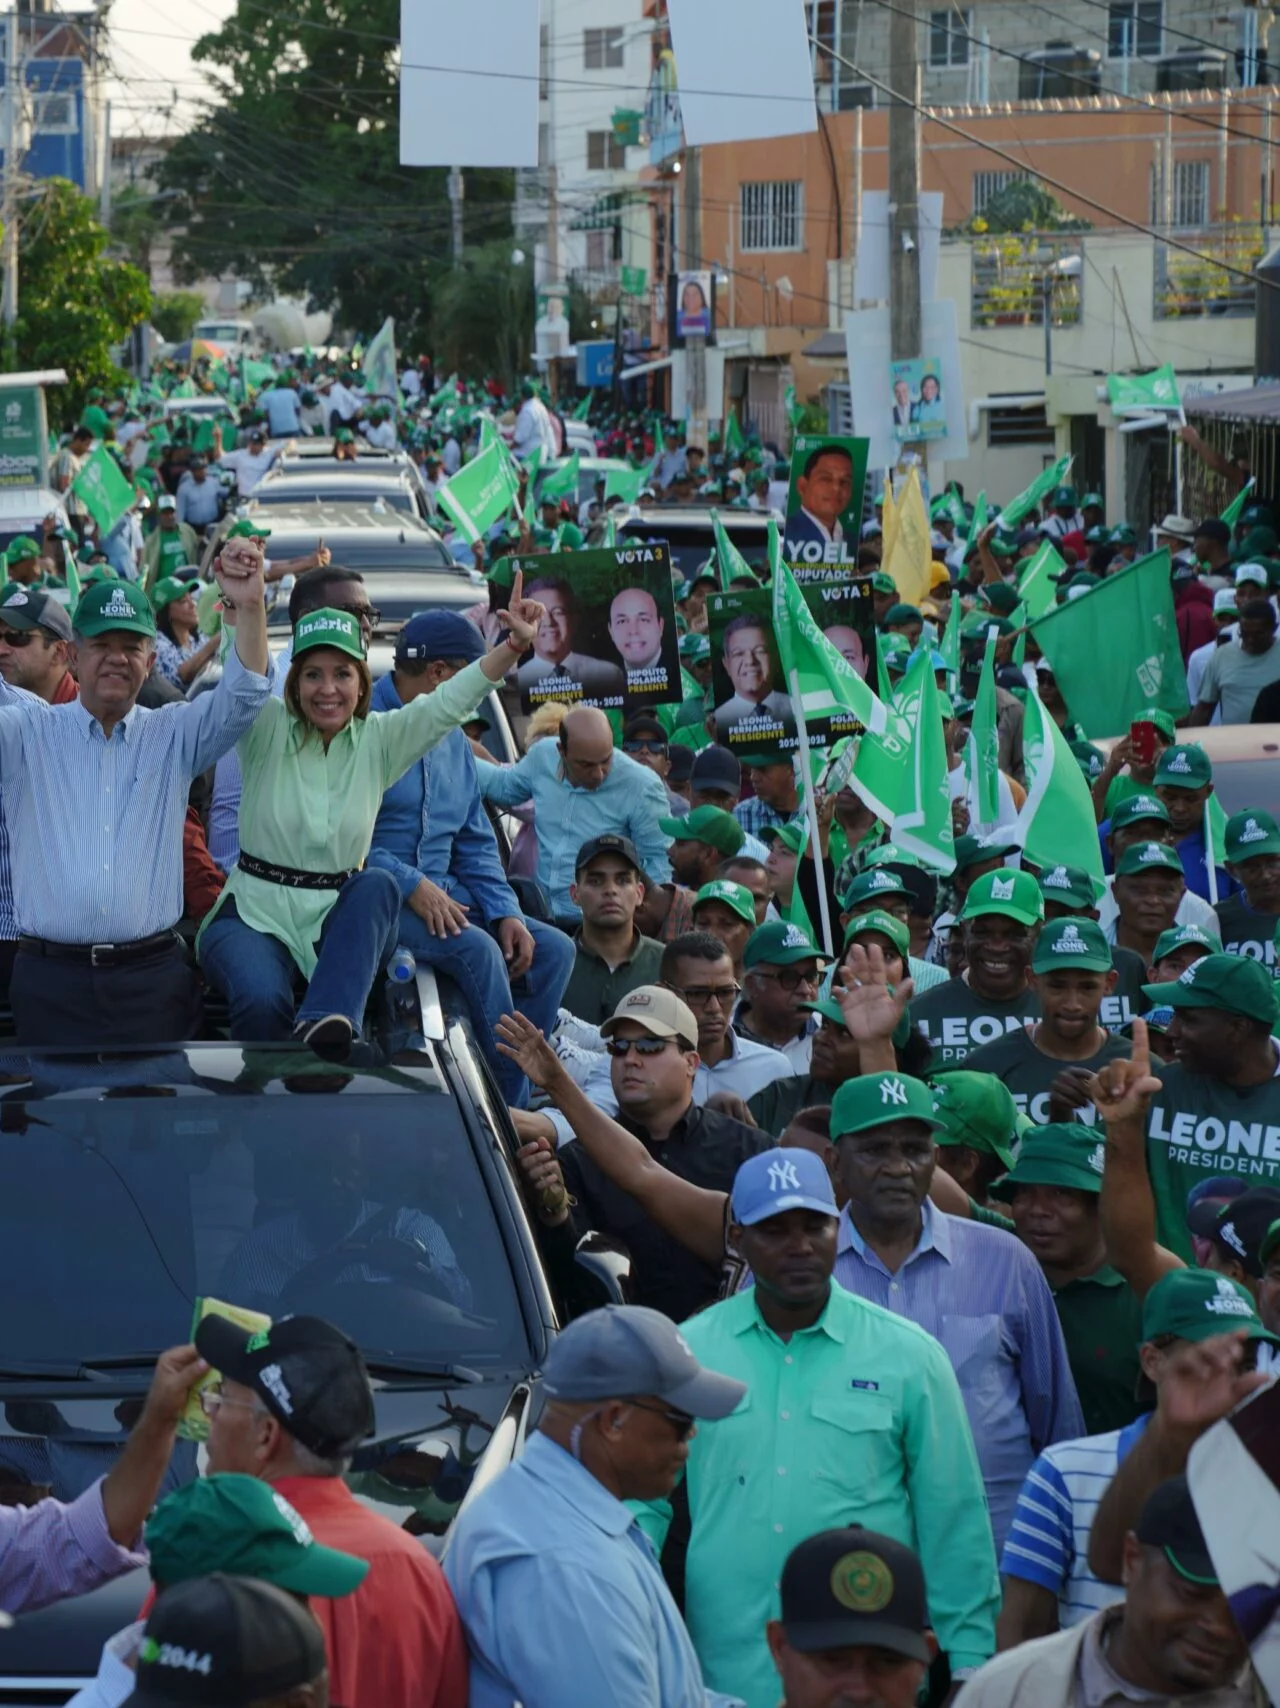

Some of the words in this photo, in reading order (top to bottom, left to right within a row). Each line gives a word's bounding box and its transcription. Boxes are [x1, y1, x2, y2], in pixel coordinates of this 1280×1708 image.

[615, 550, 653, 564] VOTA
[655, 548, 663, 560] 3
[786, 540, 855, 563] YOEL
[821, 586, 860, 601] VOTA
[862, 584, 870, 597] 3
[100, 605, 137, 615] LEONEL
[627, 668, 666, 677] HIPOLITO
[538, 676, 571, 685] LEONEL
[627, 676, 668, 685] POLANCO
[529, 683, 582, 695] FERNANDEZ
[628, 684, 668, 693] PRESENTE
[738, 716, 773, 725] LEONEL
[830, 715, 858, 725] POLAN
[728, 722, 784, 735] FERNANDEZ
[831, 723, 863, 733] PRESEN
[728, 730, 785, 744] PRESIDENTE
[1051, 941, 1089, 952] LEONEL
[918, 1016, 1043, 1047] LEON
[879, 1077, 908, 1105] NY
[1148, 1106, 1280, 1160] LEONE
[1168, 1146, 1280, 1177] PRESIDENT
[767, 1159, 801, 1192] NY
[159, 1642, 213, 1676] 2044
